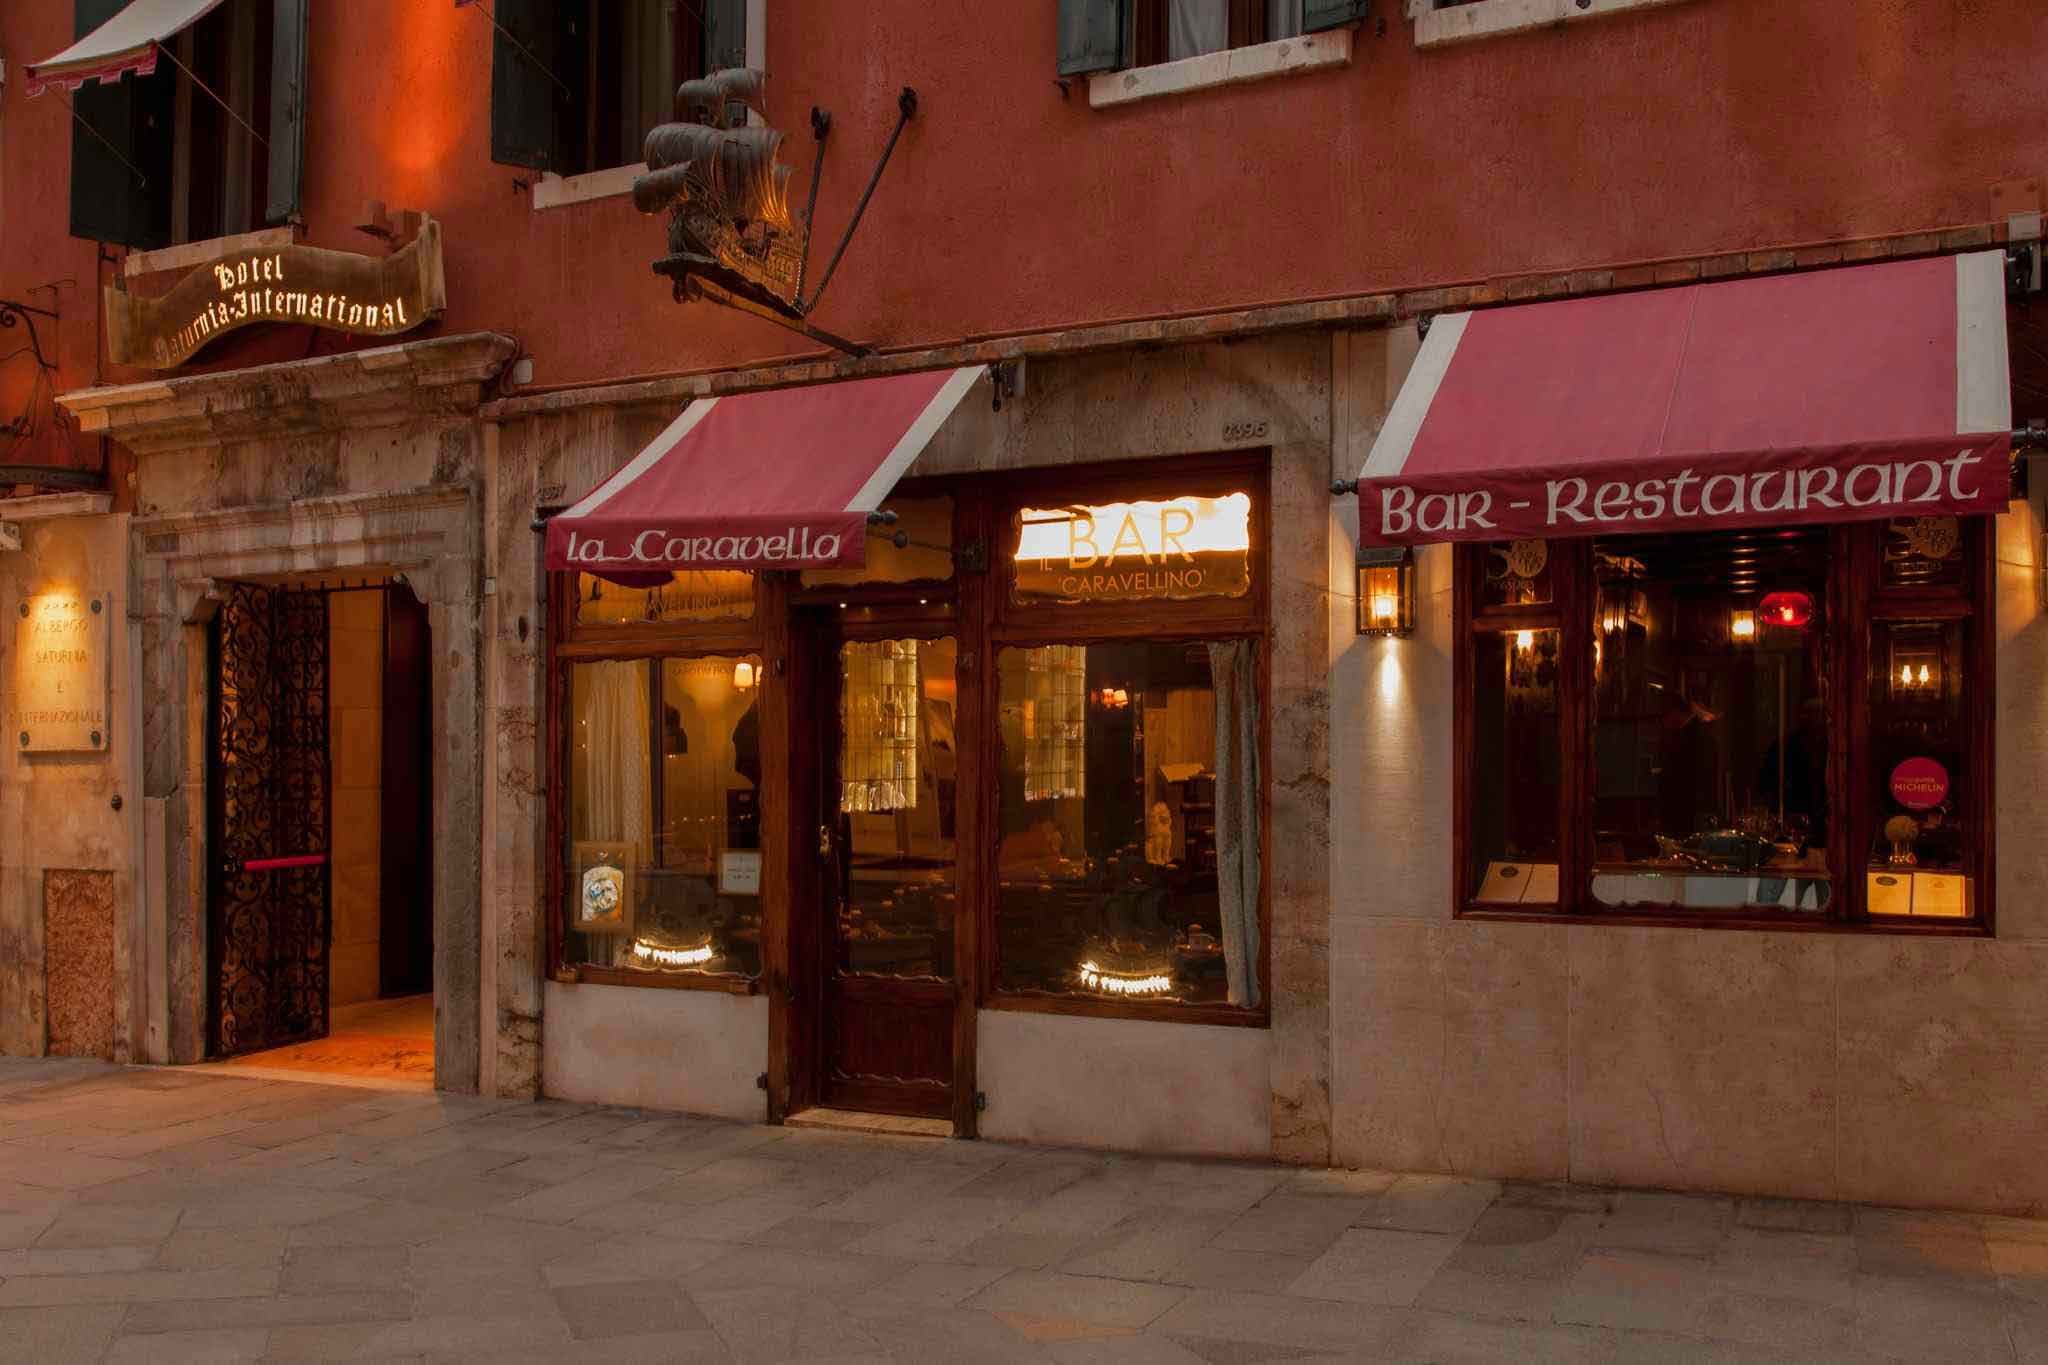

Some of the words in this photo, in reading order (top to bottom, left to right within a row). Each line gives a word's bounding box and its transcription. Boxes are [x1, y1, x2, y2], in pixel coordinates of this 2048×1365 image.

[214, 254, 283, 290] Hotel
[1381, 484, 1496, 535] Bar
[1546, 448, 1982, 525] Restaurant
[631, 526, 841, 561] Caravella
[1068, 508, 1195, 570] BAR
[1894, 783, 1945, 793] MICHELIN
